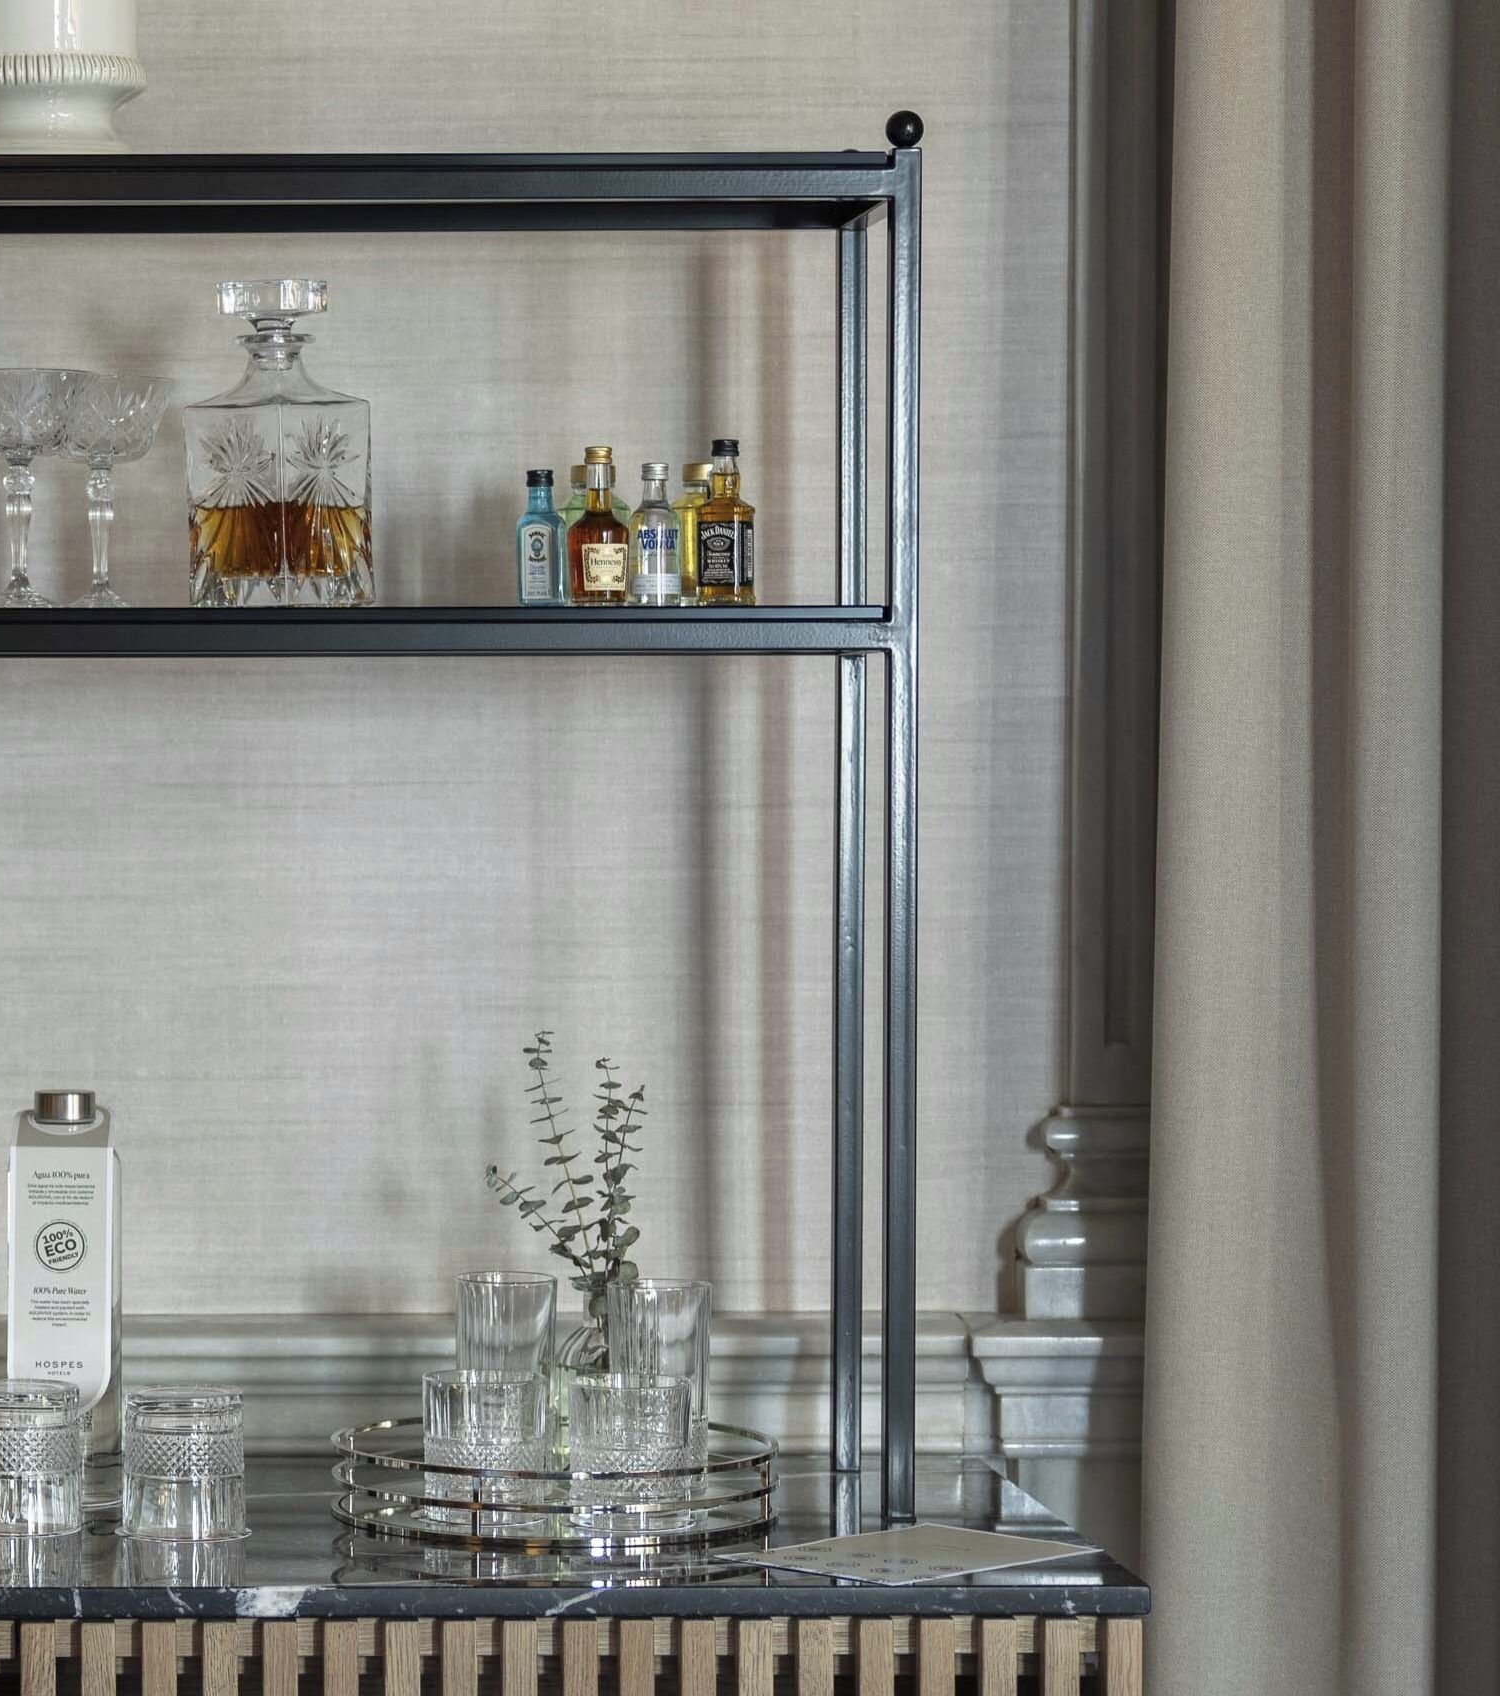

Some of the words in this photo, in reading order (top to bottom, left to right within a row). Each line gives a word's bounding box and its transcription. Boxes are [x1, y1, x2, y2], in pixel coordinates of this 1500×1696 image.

[590, 558, 622, 567] Hennessy
[33, 1171, 51, 1179] Agua
[51, 1171, 73, 1179] 100%
[73, 1172, 90, 1181] pura
[42, 1229, 74, 1244] 100%
[44, 1238, 77, 1258] ECO
[48, 1251, 79, 1265] FRIENDLY
[33, 1286, 51, 1295] 100%
[52, 1286, 67, 1295] Pure
[67, 1286, 87, 1295] Water
[35, 1360, 84, 1369] HOSPES
